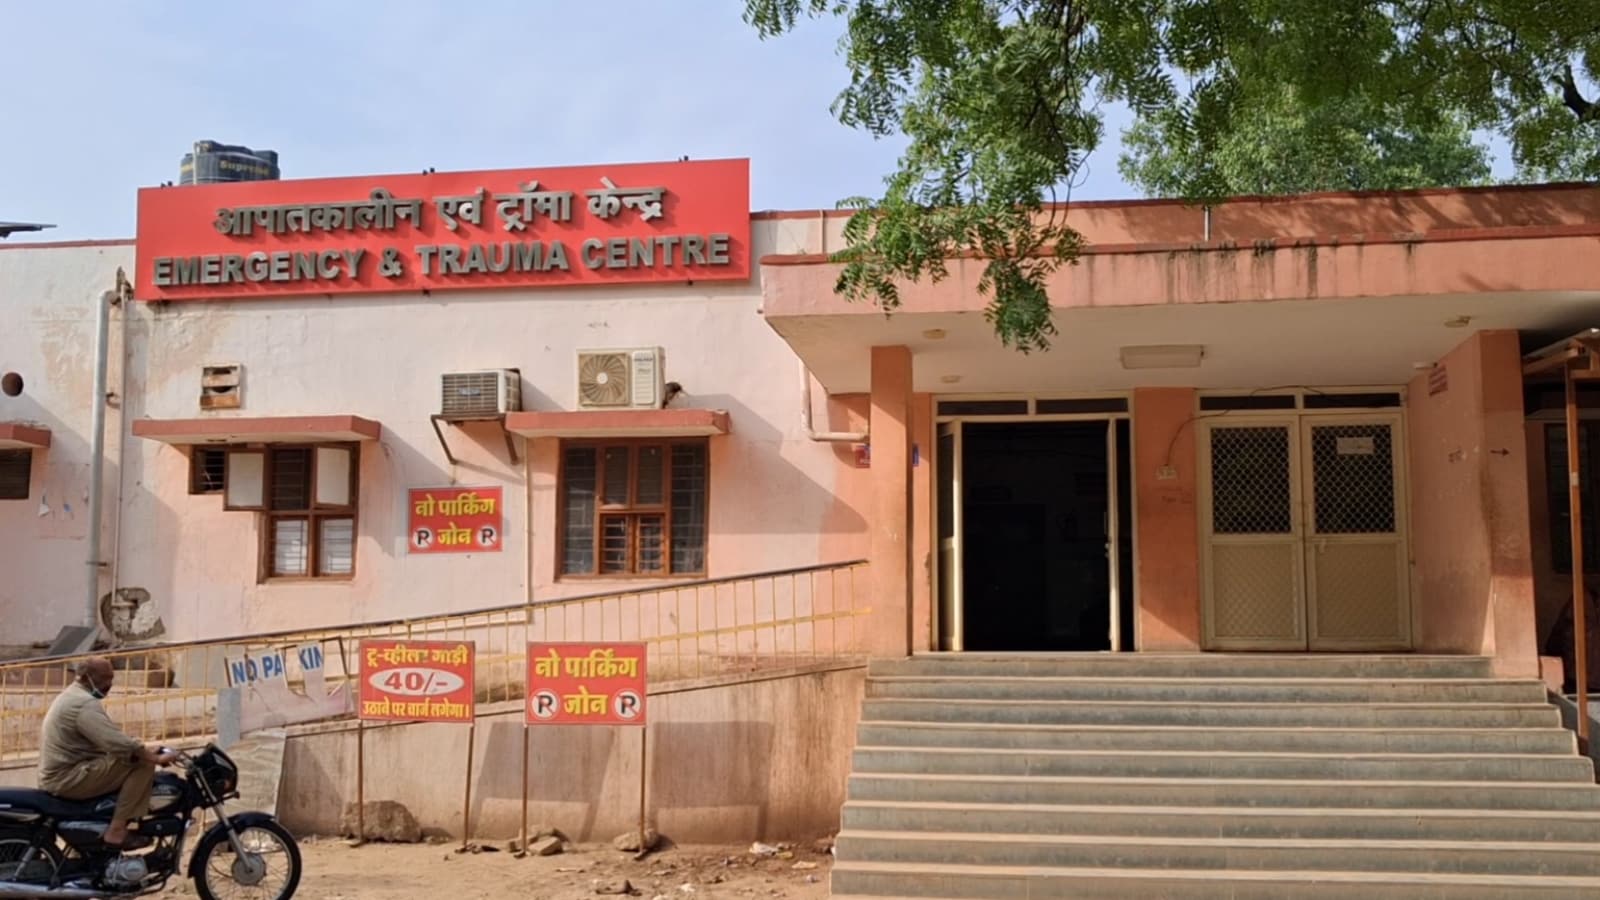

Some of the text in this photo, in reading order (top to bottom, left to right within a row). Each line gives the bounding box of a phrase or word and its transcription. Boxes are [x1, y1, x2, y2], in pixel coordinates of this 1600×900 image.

[214, 176, 666, 236] आपातकालीन एवं ट्रॉमा केन्द्र
[153, 232, 731, 287] EMERGENCY & TRAUMA CENTRE
[415, 491, 496, 516] नो पार्किंग
[437, 521, 472, 545] जोन
[431, 644, 469, 667] गाड़ी
[535, 648, 638, 678] नो पार्किंग
[231, 658, 258, 684] NO
[384, 671, 449, 693] 40/-
[392, 702, 405, 717] पर
[407, 697, 430, 717] चार्ज
[563, 685, 608, 715] जोन
